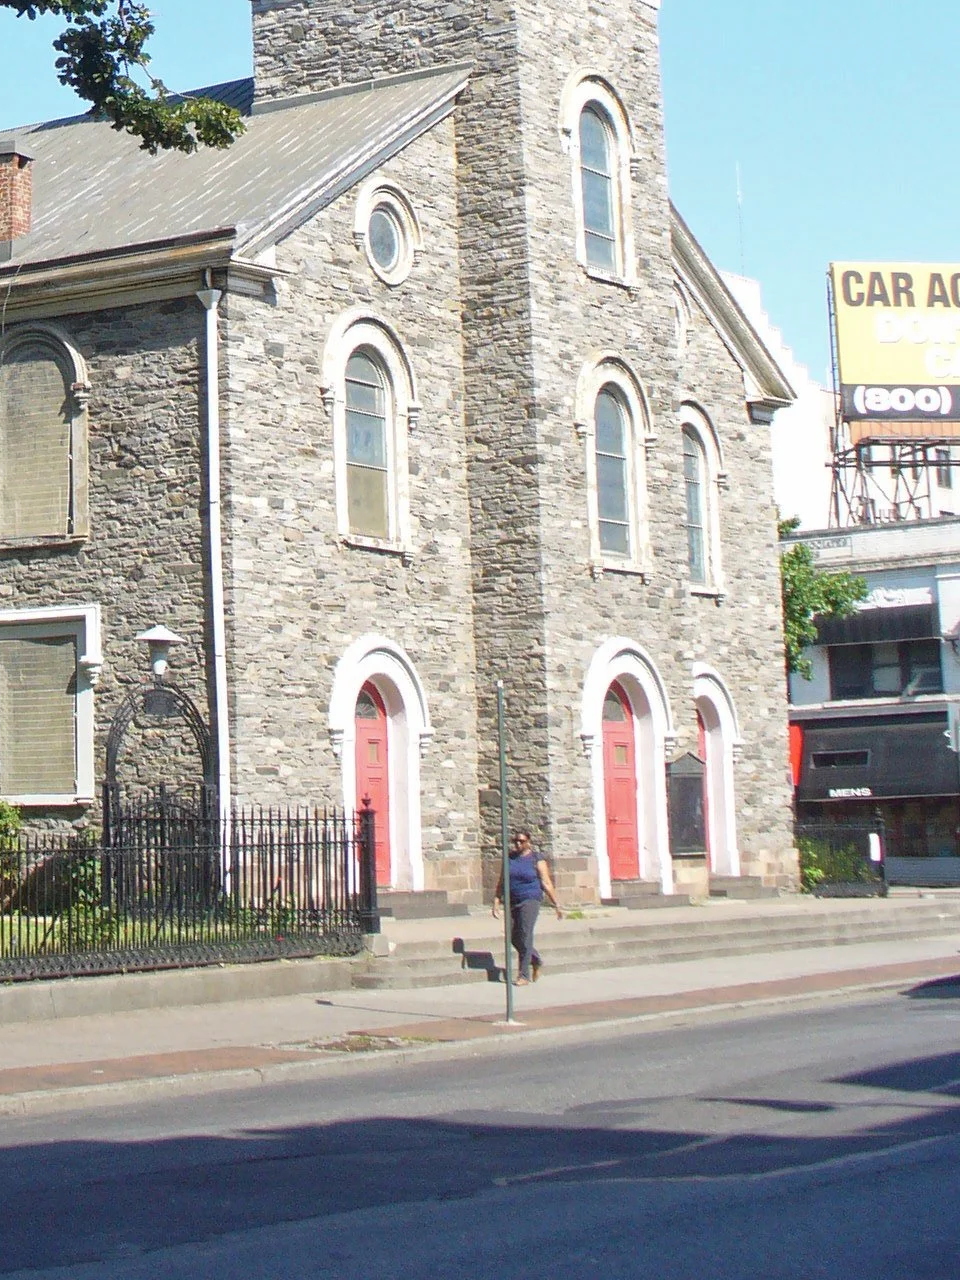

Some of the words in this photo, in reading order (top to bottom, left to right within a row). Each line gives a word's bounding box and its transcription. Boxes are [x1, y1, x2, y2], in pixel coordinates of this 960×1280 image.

[842, 270, 915, 307] CAR
[854, 386, 952, 414] (800)
[829, 787, 872, 797] MENS
